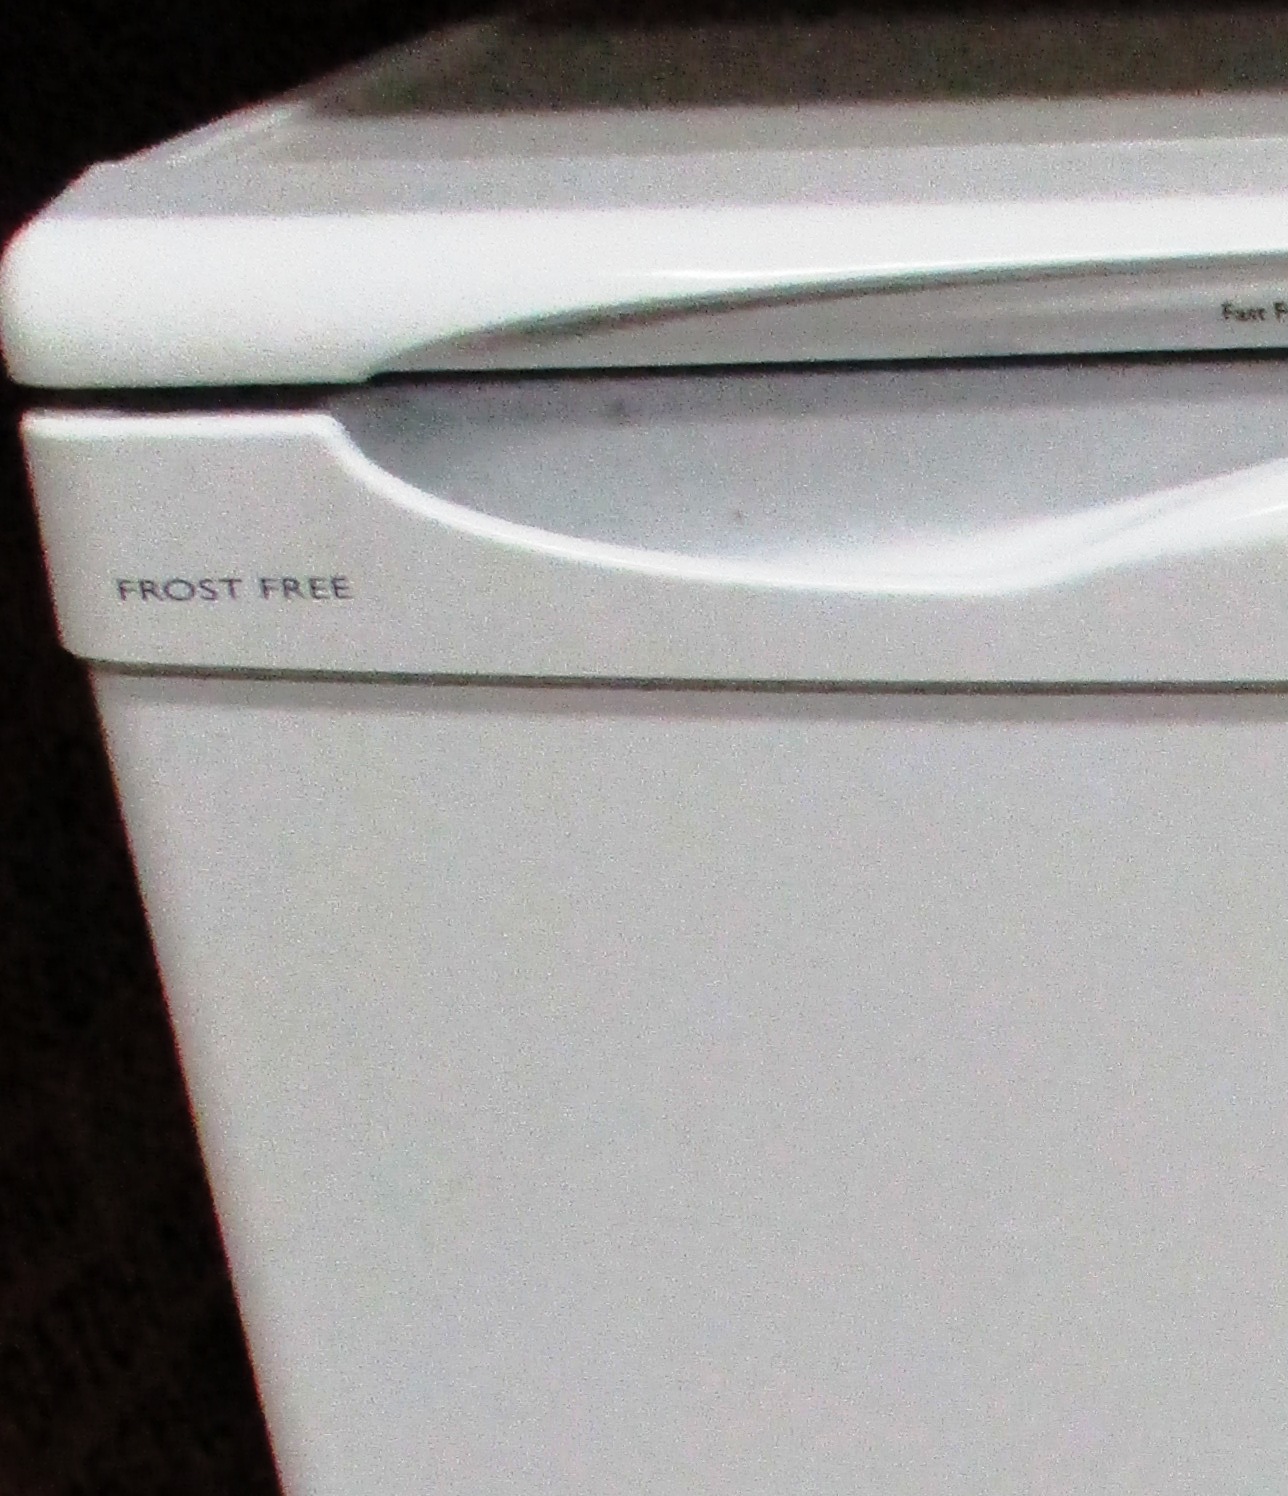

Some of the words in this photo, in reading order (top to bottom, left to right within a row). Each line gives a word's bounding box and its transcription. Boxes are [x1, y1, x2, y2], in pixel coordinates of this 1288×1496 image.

[1220, 299, 1267, 322] Fast
[116, 577, 243, 602] FROST
[259, 575, 353, 600] FREE
